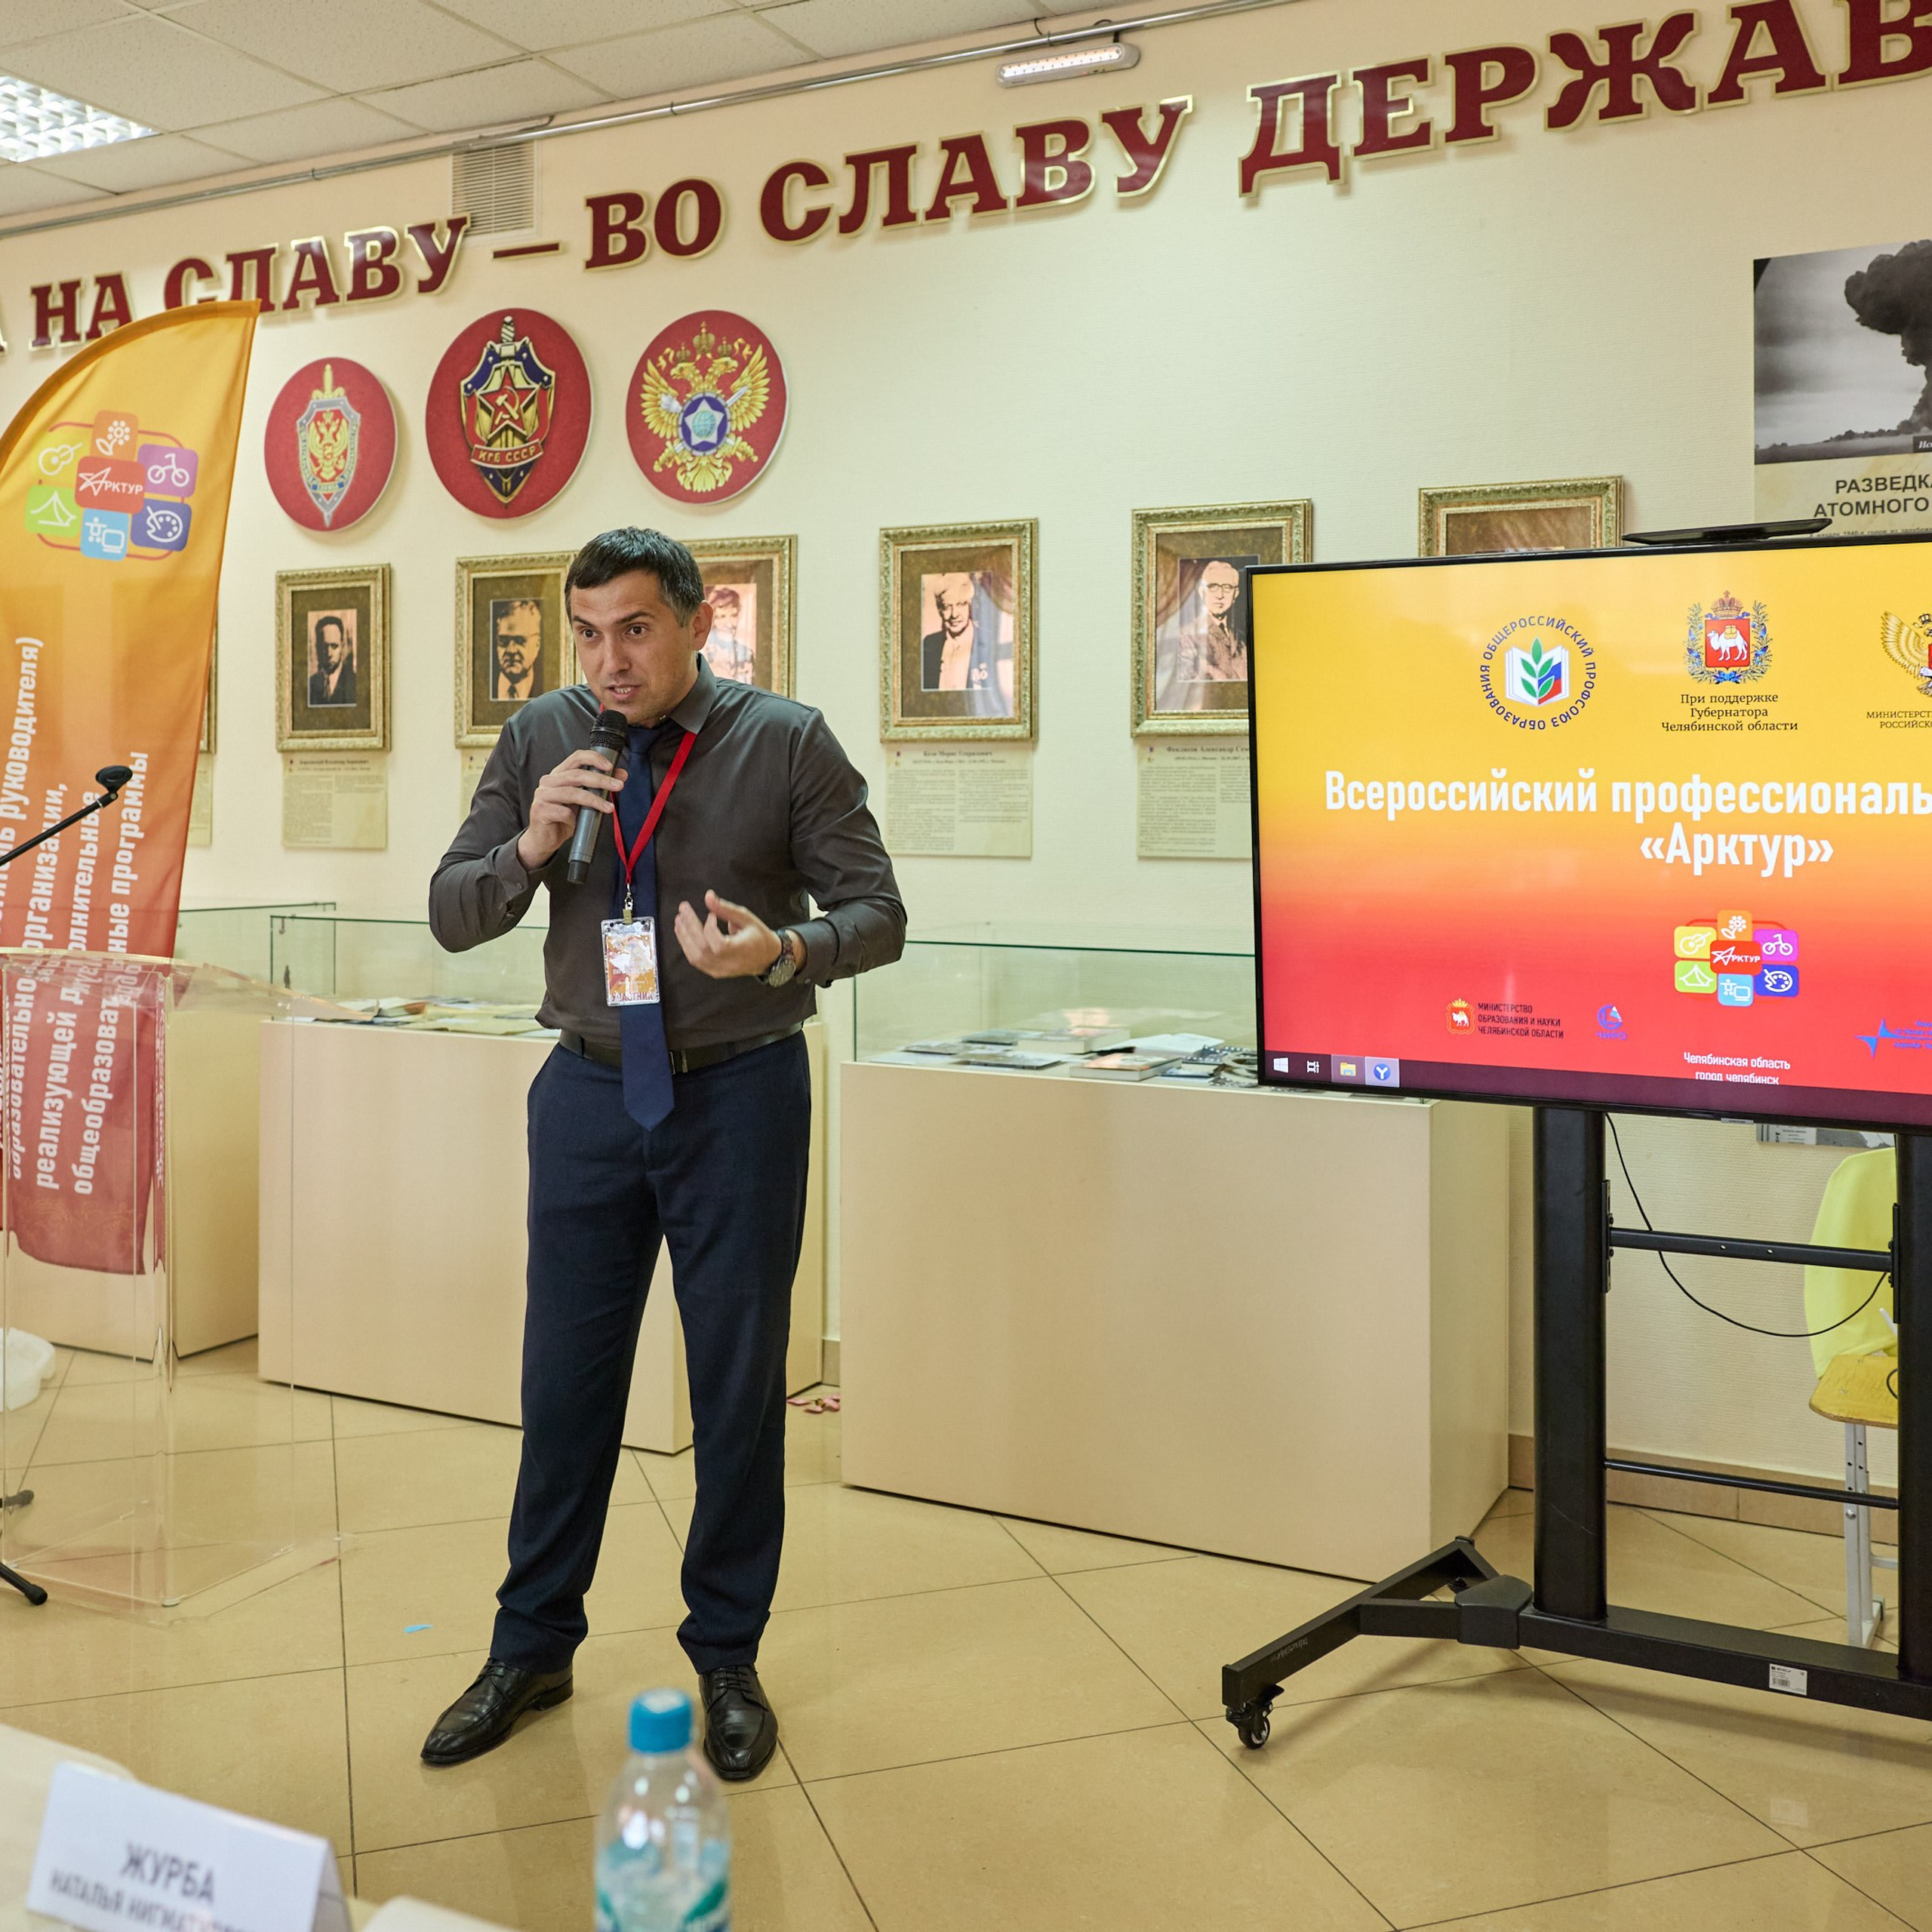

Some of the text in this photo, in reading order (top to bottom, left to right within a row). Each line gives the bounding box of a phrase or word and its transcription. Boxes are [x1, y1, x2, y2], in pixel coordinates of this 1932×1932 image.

[30, 272, 134, 349] НА
[164, 214, 471, 313] СЛАВУ
[584, 177, 724, 270] ВО
[760, 95, 1193, 245] СЛАВУ
[478, 445, 537, 463] КГБ СССР
[1918, 441, 1932, 449] Ис
[1835, 474, 1932, 494] РАЗВЕДК
[1814, 497, 1930, 518] АТОМНОГО
[1480, 616, 1596, 730] ОБЩЕРОССИЙСКИЙ ПРОФСОЮЗ ОБРАЗОВАНИЯ
[1681, 694, 1779, 706] При поддержке
[1690, 707, 1768, 719] Губернатора
[1866, 710, 1932, 718] МИНИСТЕРСТ
[0, 637, 44, 820] руководителя)
[1662, 721, 1798, 731] Челябинской области
[1325, 768, 1932, 824] Всероссийский профессиональ
[1640, 821, 1835, 878] «Арктур»
[611, 992, 654, 1002] УЧАСТНИК
[1478, 1002, 1533, 1014] МИНИСТЕРСТВО
[1478, 1014, 1528, 1025] ОБРАЗОВАНИЯ
[1537, 1018, 1561, 1026] НАУКИ
[1478, 1026, 1564, 1038] ЧЕЛЯБИНСКОЙ ОБЛАСТИ
[1683, 1051, 1791, 1069] Челябинская область
[1726, 1072, 1780, 1085] челябинск
[37, 1011, 77, 1190] реализующей
[120, 1840, 215, 1903] ЖУРБА
